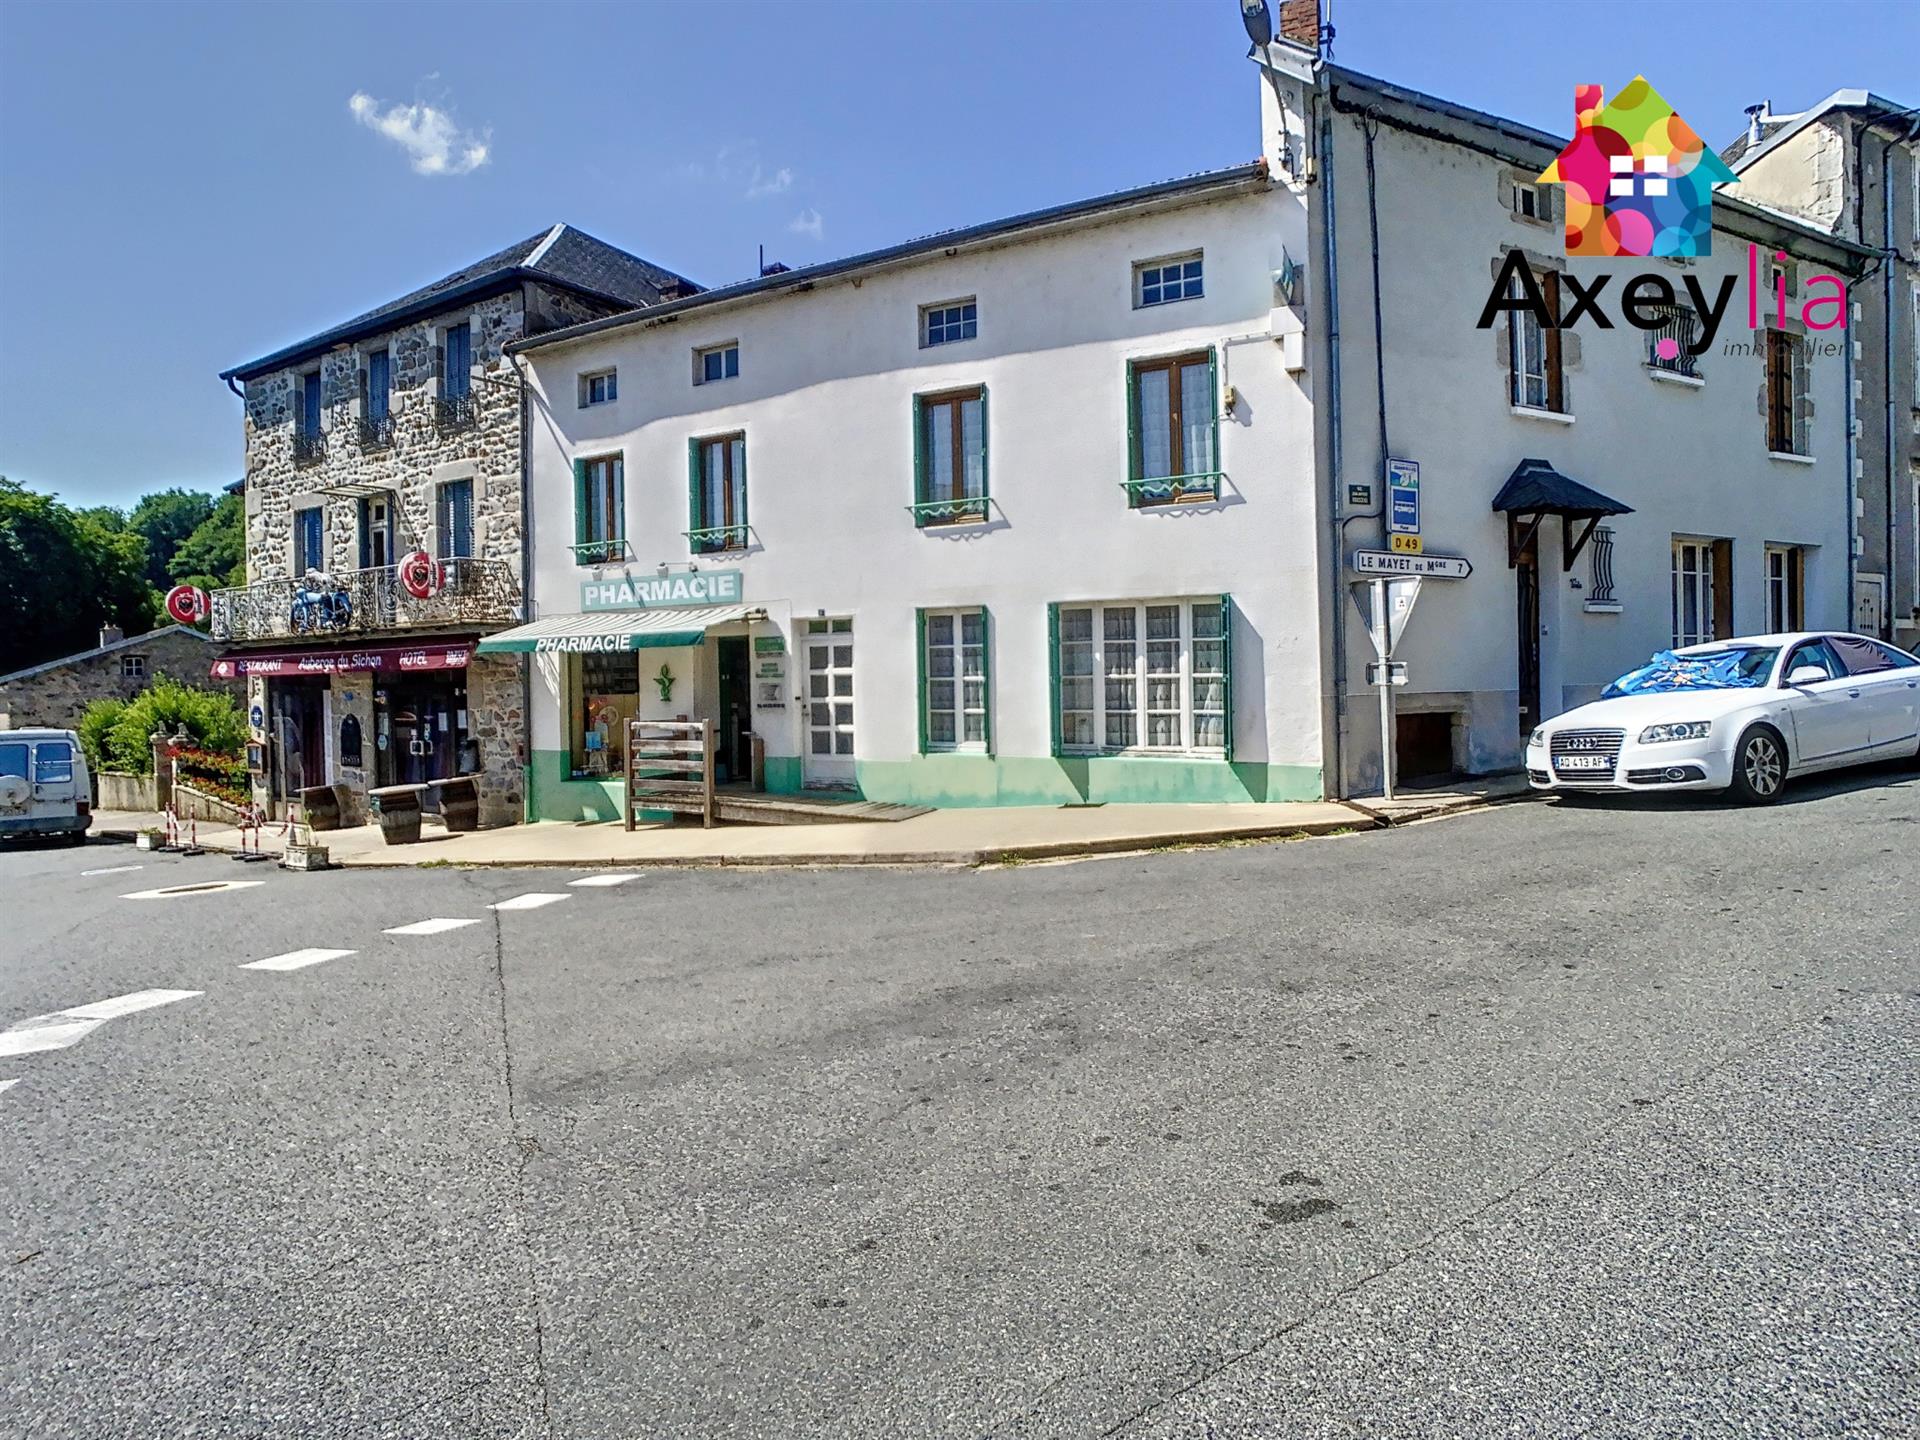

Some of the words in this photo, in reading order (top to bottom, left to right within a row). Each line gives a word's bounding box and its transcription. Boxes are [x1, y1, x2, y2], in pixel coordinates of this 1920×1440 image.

[1395, 538, 1402, 549] D
[1405, 538, 1418, 550] 49
[1361, 556, 1373, 568] LE
[1378, 557, 1411, 570] MAYET
[1457, 563, 1463, 574] 7
[585, 575, 735, 606] PHARMACIE
[535, 634, 631, 652] PHARMACIE
[238, 659, 284, 673] RESTAURANT
[297, 655, 335, 673] Auberge
[337, 653, 349, 669] du
[351, 651, 382, 667] Sichon
[1573, 757, 1589, 767] 413
[1592, 757, 1603, 767] AF
